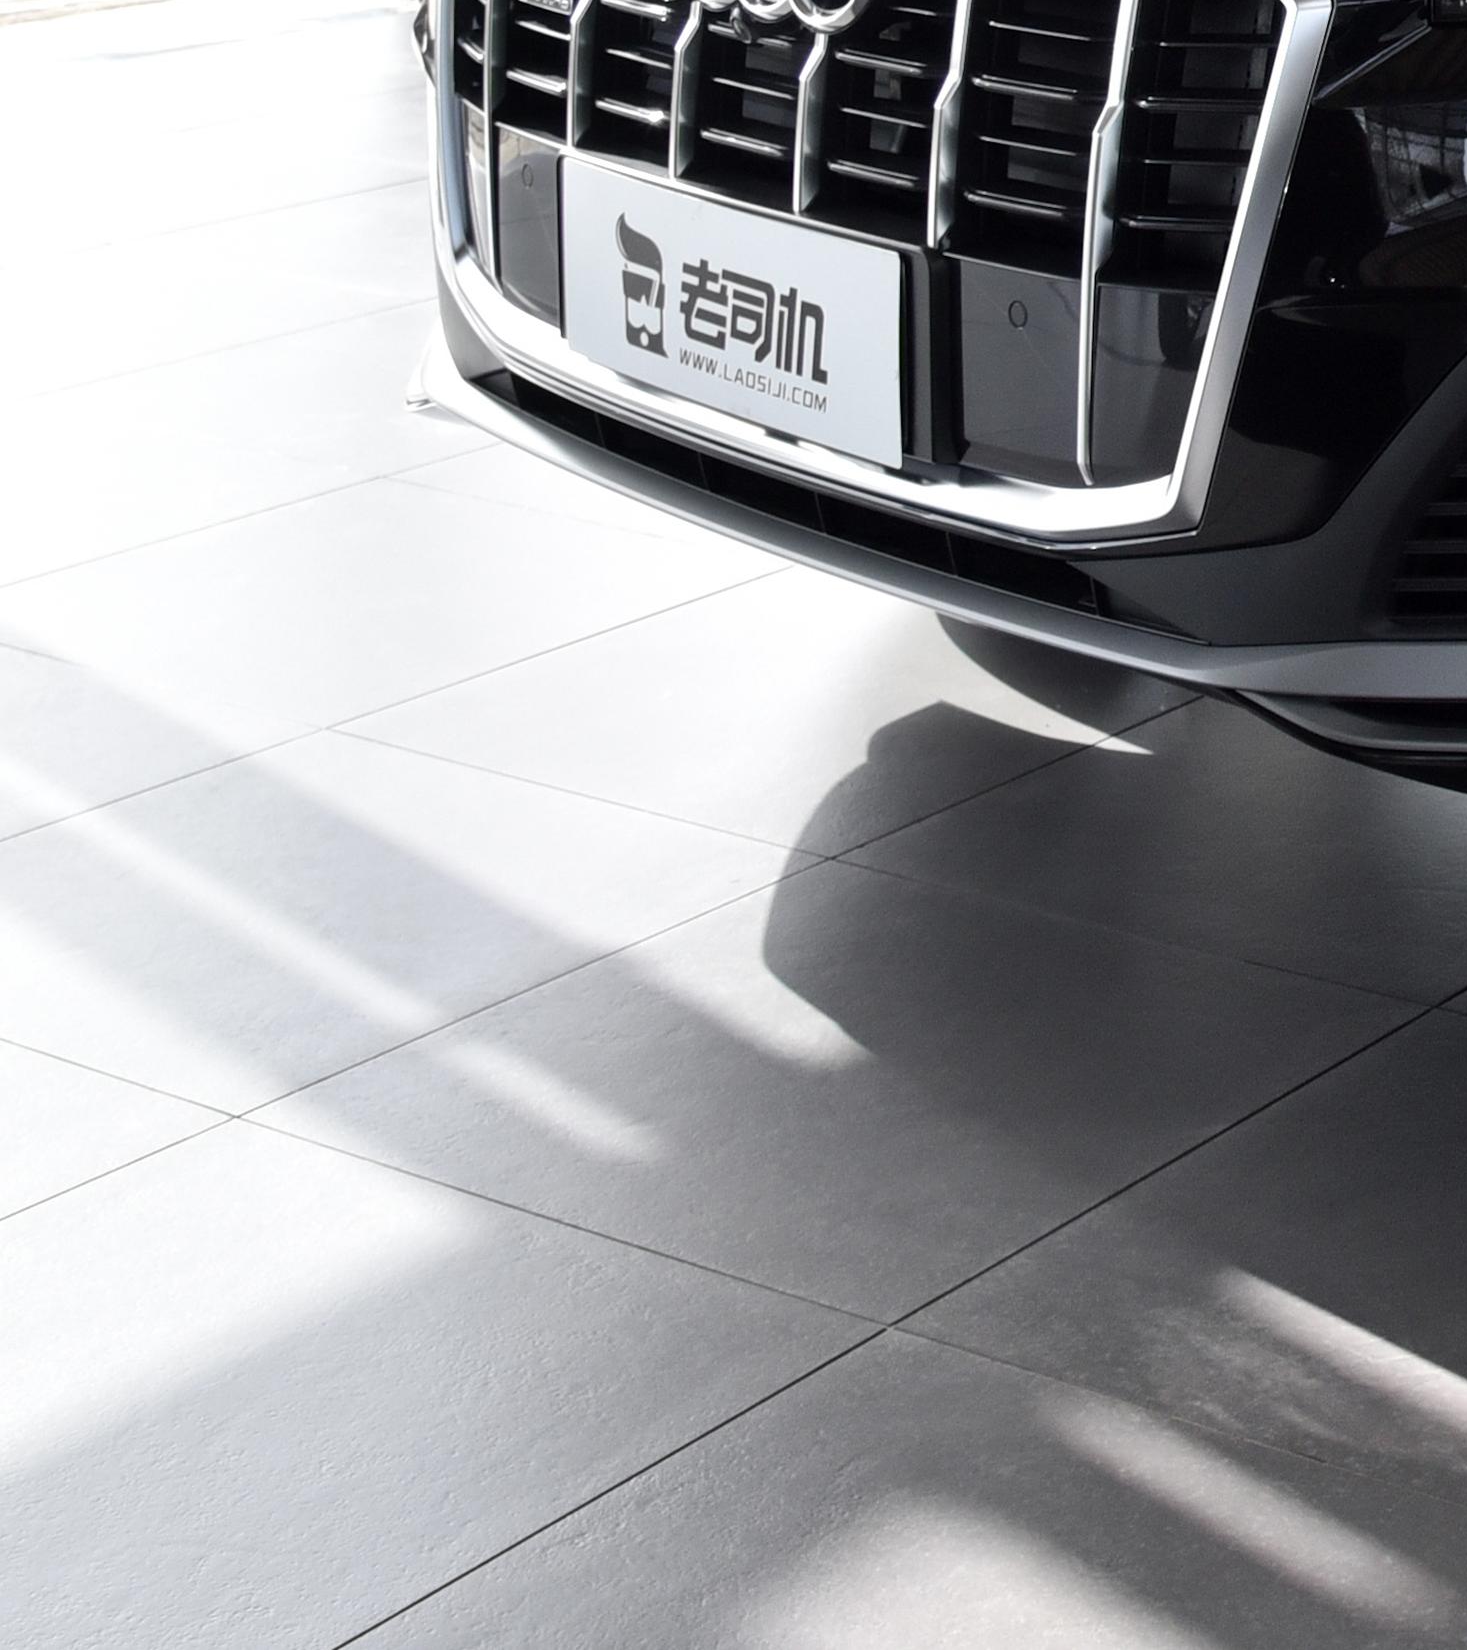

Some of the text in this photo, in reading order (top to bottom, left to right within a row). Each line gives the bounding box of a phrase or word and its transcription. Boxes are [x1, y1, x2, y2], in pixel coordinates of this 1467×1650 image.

[680, 258, 829, 385] 老司机
[679, 347, 828, 413] WWW.LAOSIJI.COM
